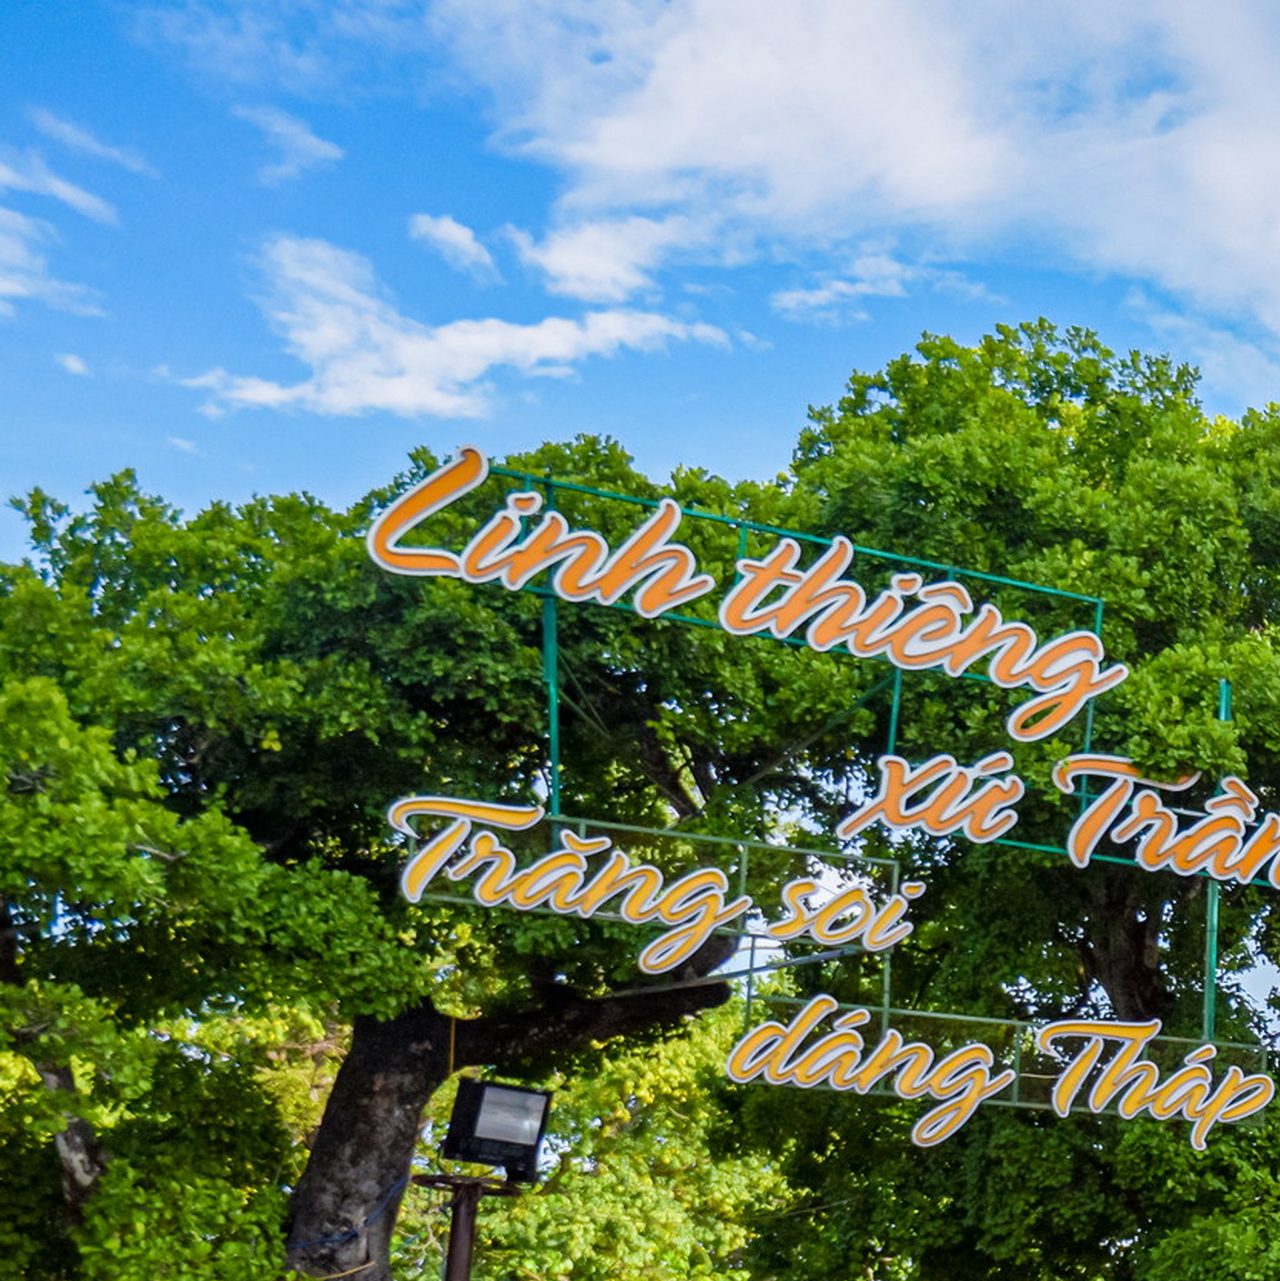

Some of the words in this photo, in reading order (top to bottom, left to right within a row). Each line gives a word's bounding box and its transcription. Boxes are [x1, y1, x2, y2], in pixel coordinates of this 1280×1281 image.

[367, 445, 713, 617] Linh
[719, 536, 1127, 741] thiêng
[388, 796, 752, 975] Trăng
[766, 880, 927, 951] soi
[727, 993, 1015, 1148] dáng
[1037, 1018, 1275, 1152] Tháp
